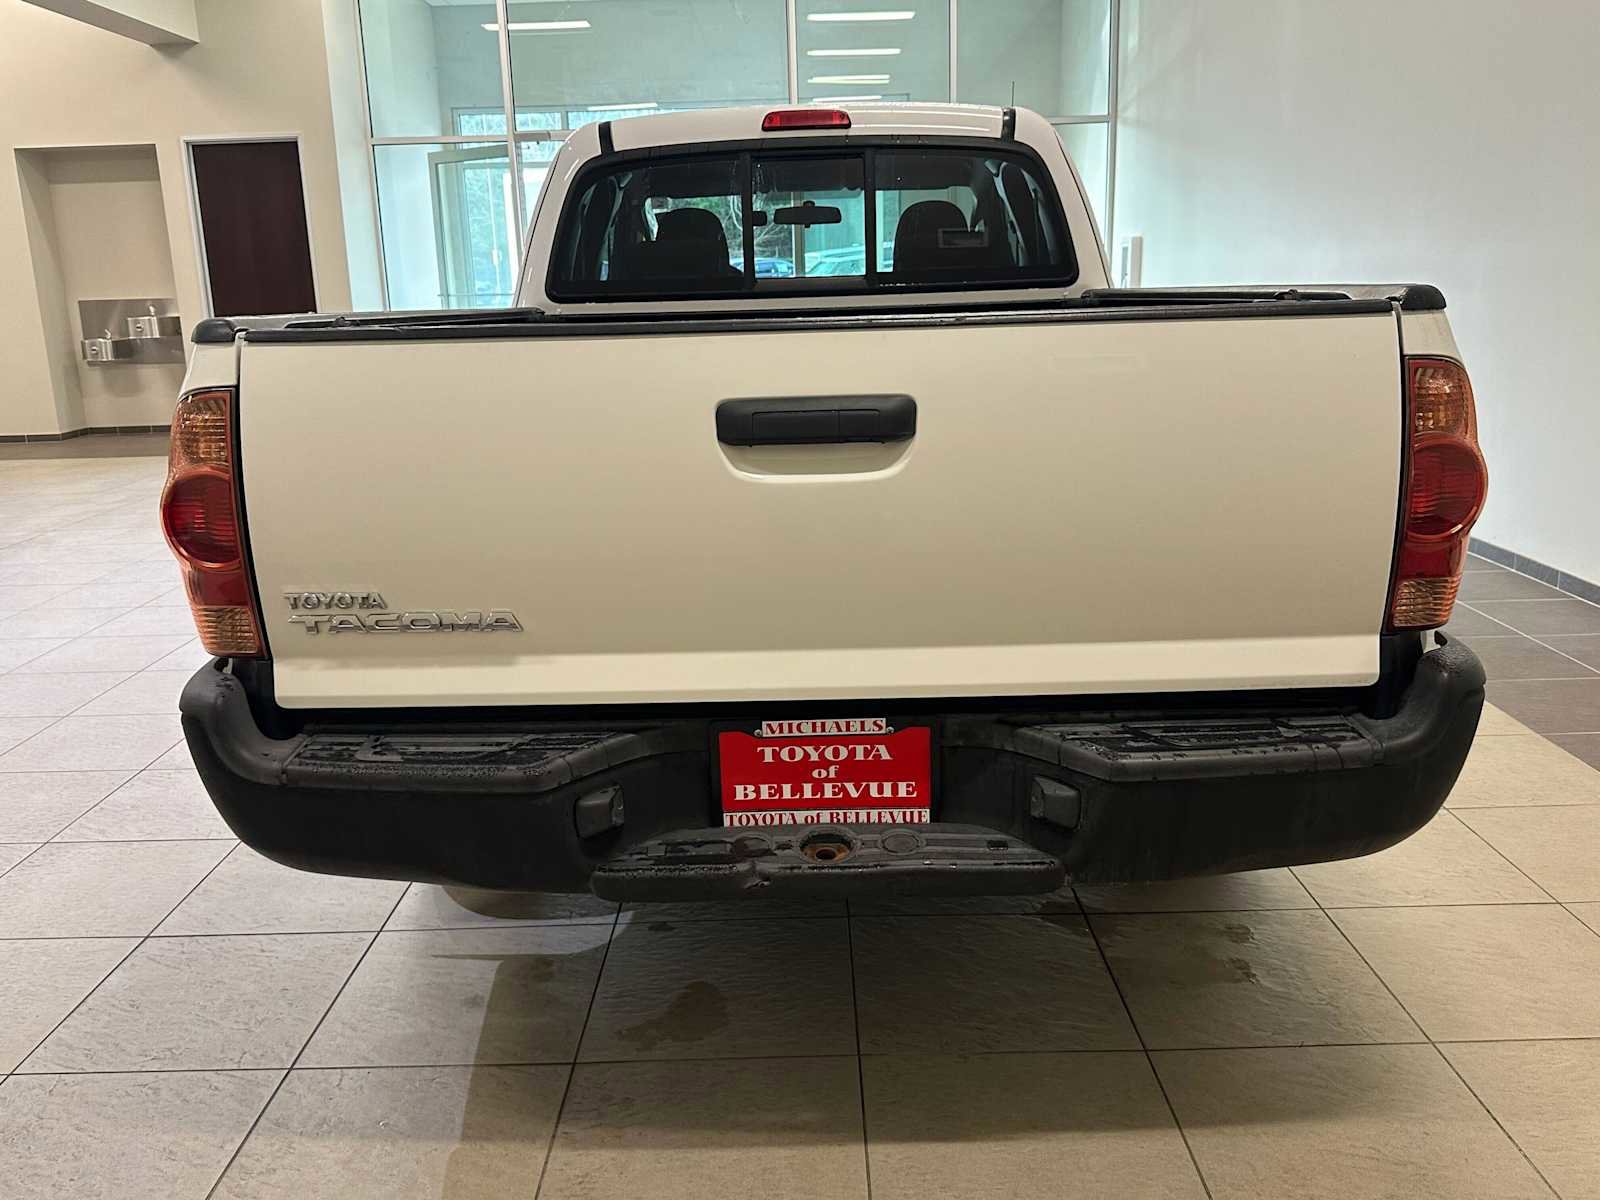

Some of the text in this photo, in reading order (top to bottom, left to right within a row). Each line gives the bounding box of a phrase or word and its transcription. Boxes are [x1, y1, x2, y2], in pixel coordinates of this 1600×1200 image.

[284, 592, 388, 610] TOYOTA
[288, 608, 524, 634] TACOMA
[765, 719, 885, 735] MICHAELS
[757, 744, 893, 763] TOYOTA
[811, 765, 840, 779] of
[733, 781, 918, 801] BELLEVUE
[725, 809, 929, 827] TOYOTA of BELLEVUE
